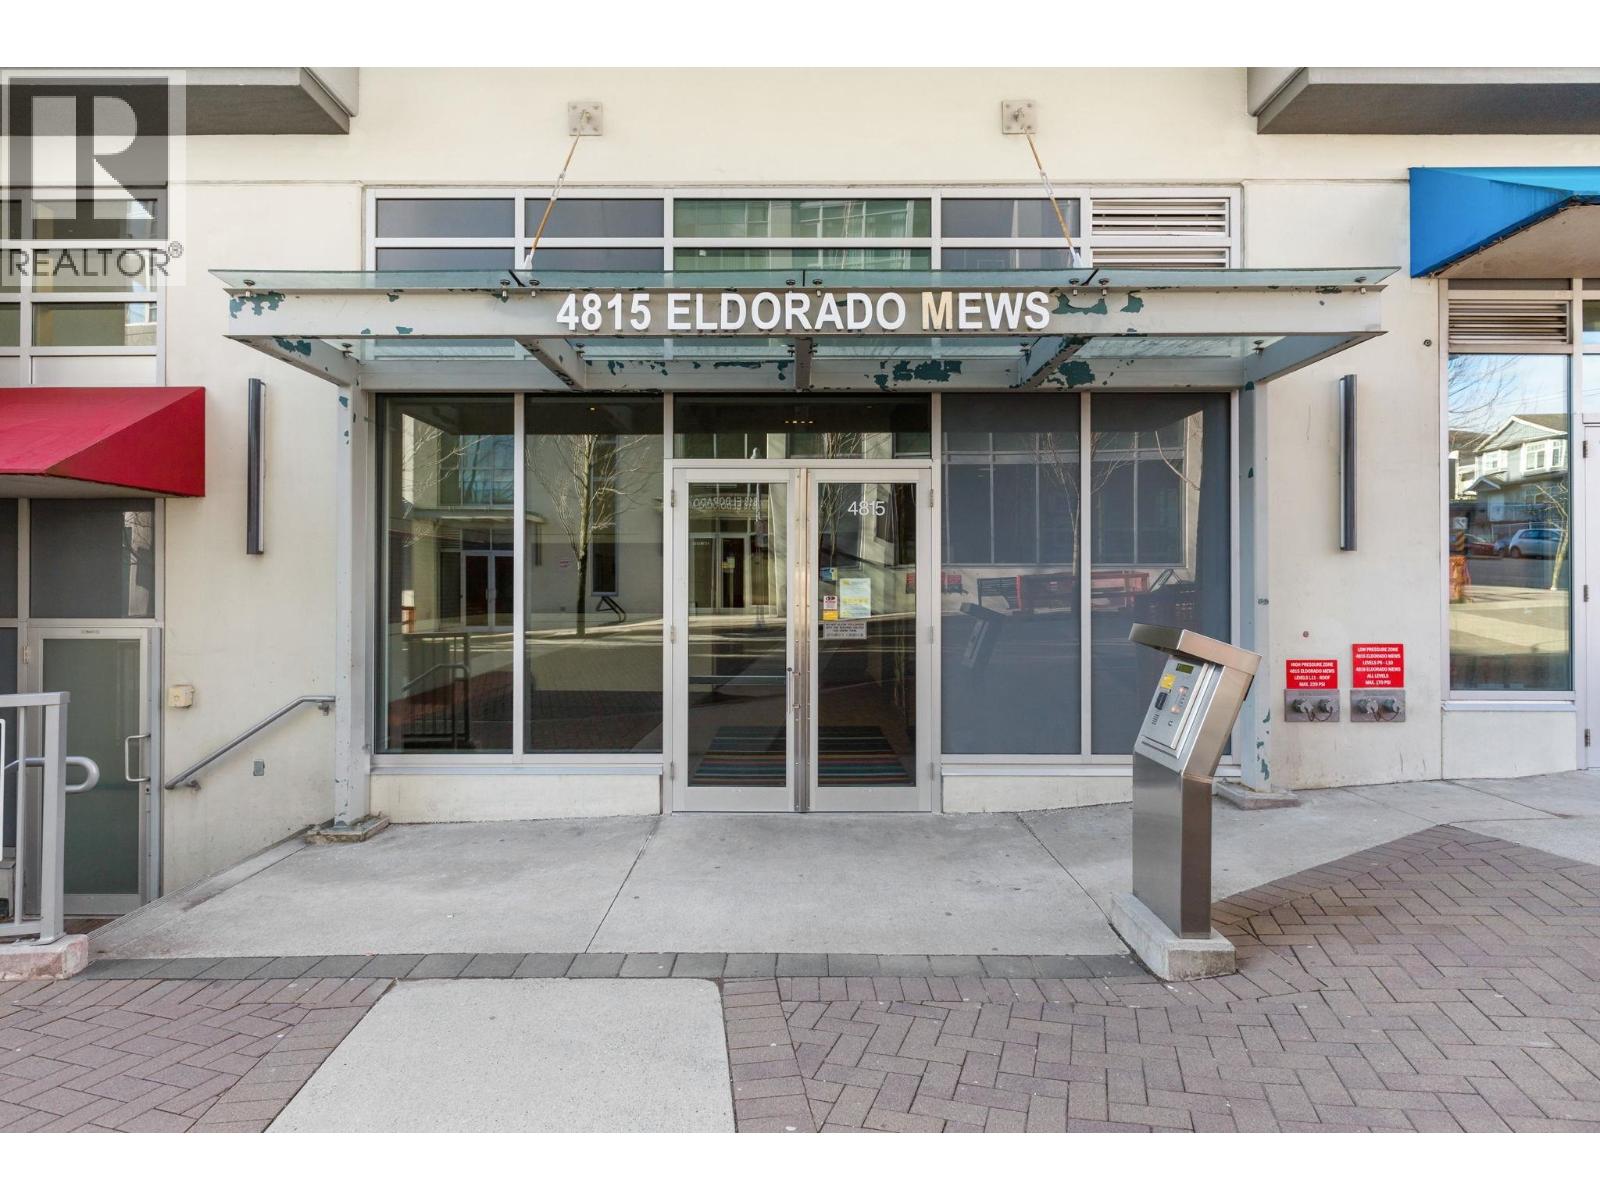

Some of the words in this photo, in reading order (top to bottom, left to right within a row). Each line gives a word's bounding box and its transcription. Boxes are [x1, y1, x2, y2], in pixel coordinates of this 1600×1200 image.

[555, 292, 651, 332] 4815
[666, 291, 906, 332] ELDORADO
[921, 290, 1051, 331] MEWS
[847, 500, 886, 517] 4815
